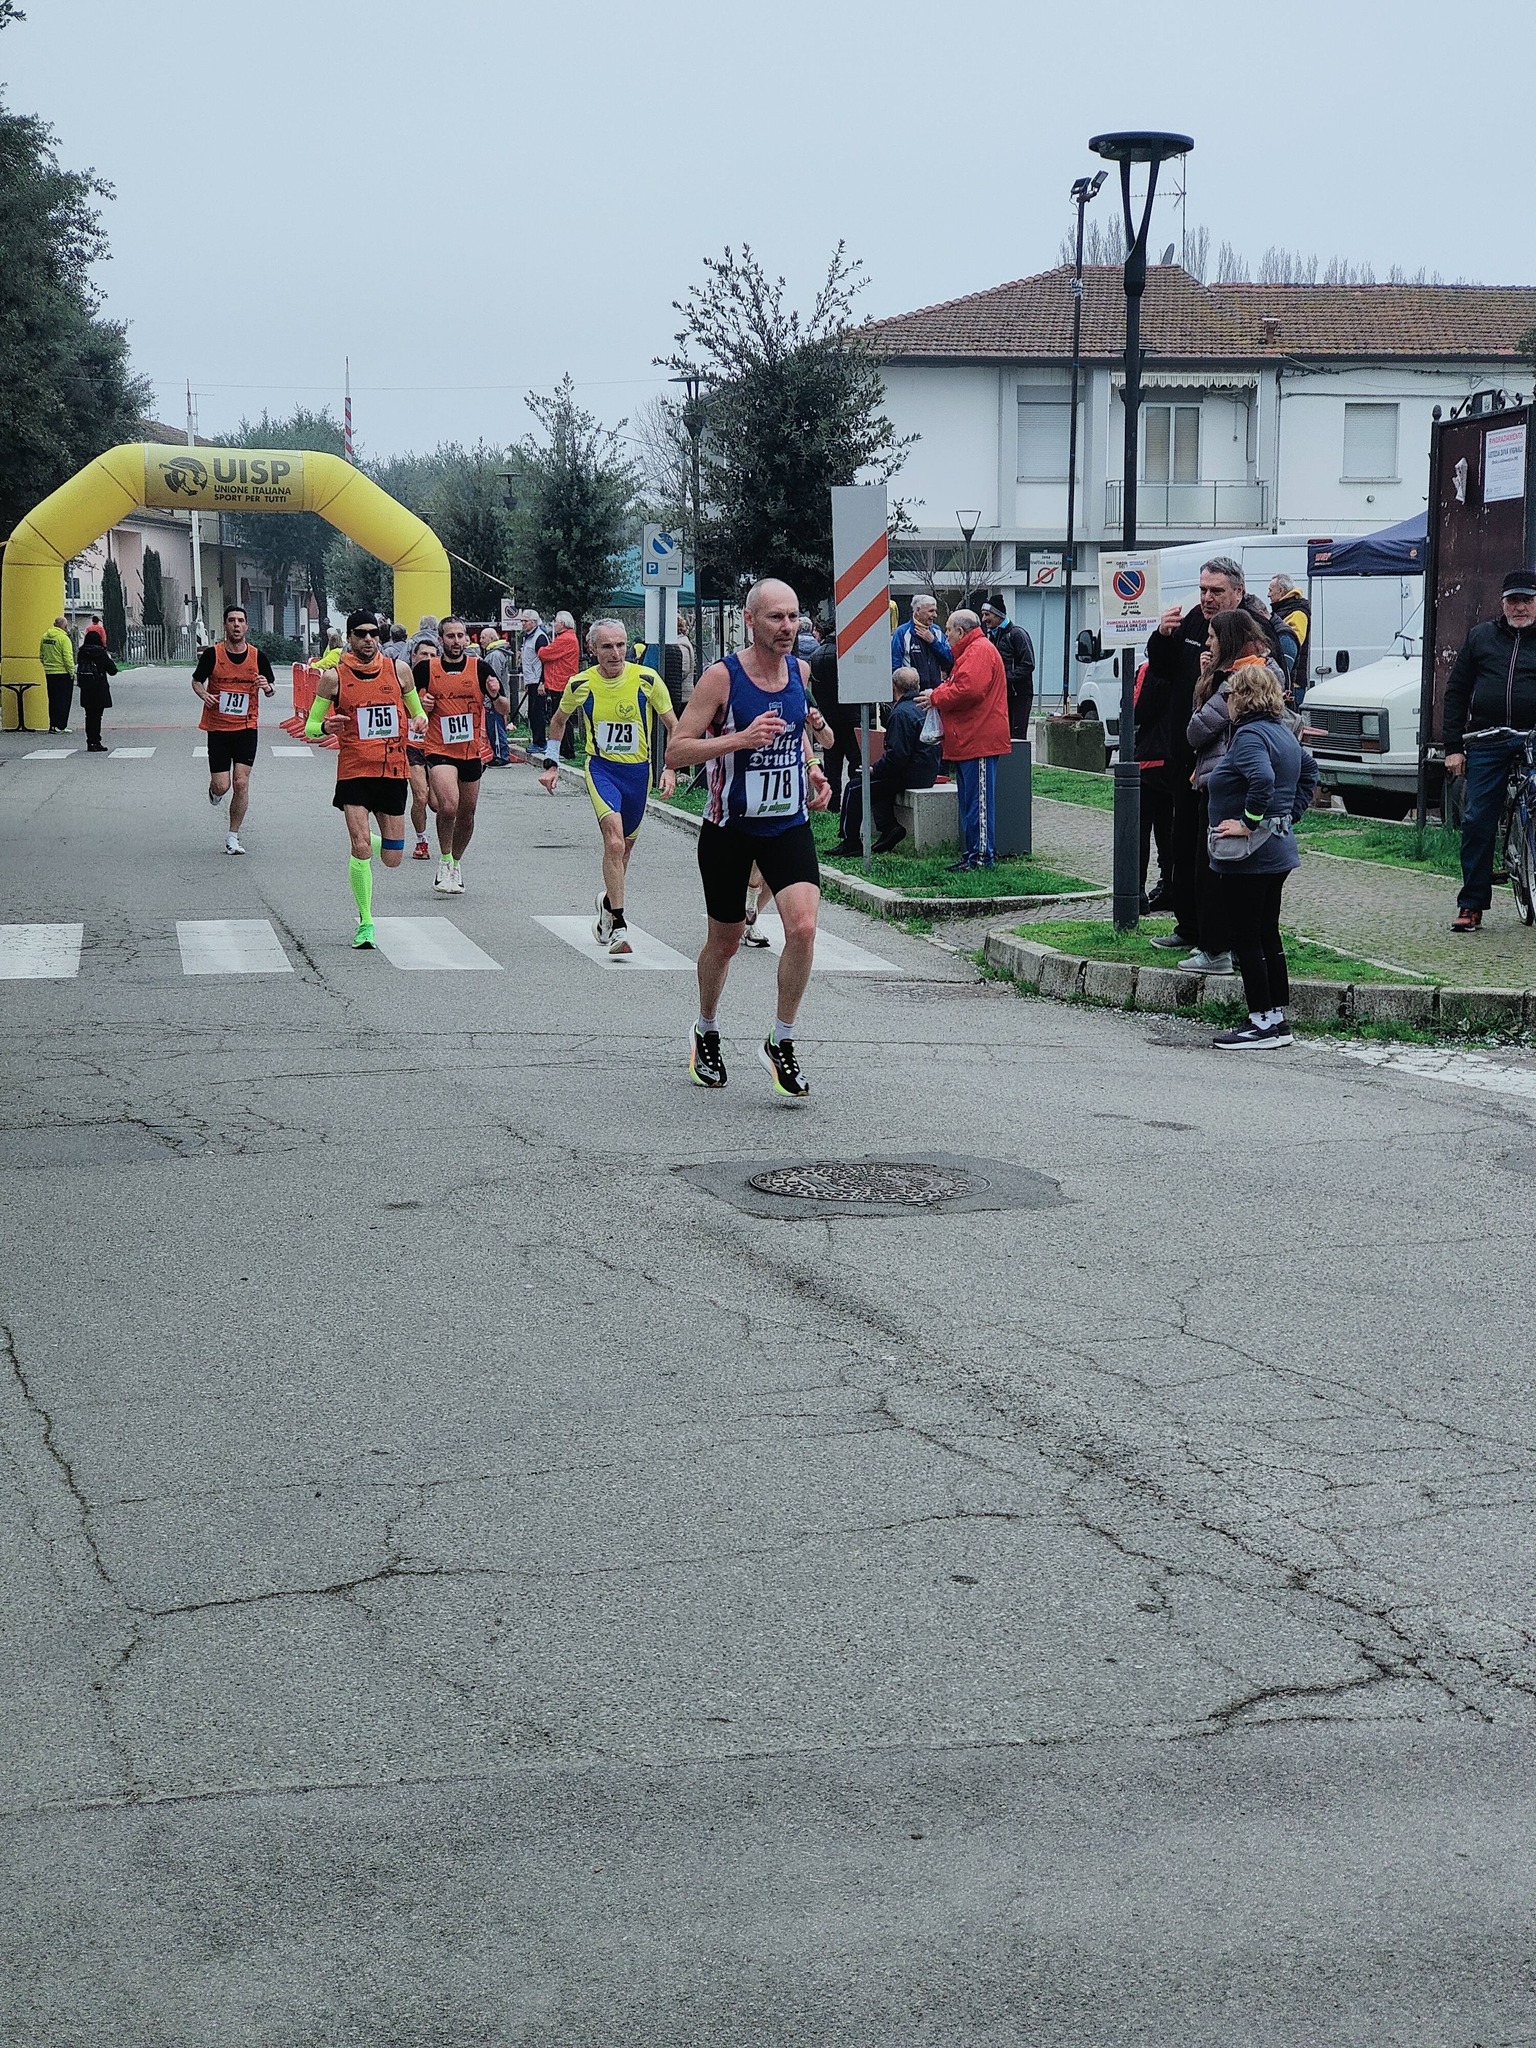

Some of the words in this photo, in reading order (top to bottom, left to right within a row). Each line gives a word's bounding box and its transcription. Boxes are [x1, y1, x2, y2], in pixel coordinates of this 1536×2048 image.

[213, 458, 290, 484] UISP
[214, 485, 248, 494] UNIONE
[252, 487, 292, 495] ITALIANA
[648, 563, 656, 573] P
[227, 693, 244, 707] 737
[366, 707, 392, 728] 755
[448, 715, 468, 734] 614
[607, 723, 632, 743] 723
[759, 769, 792, 801] 778
